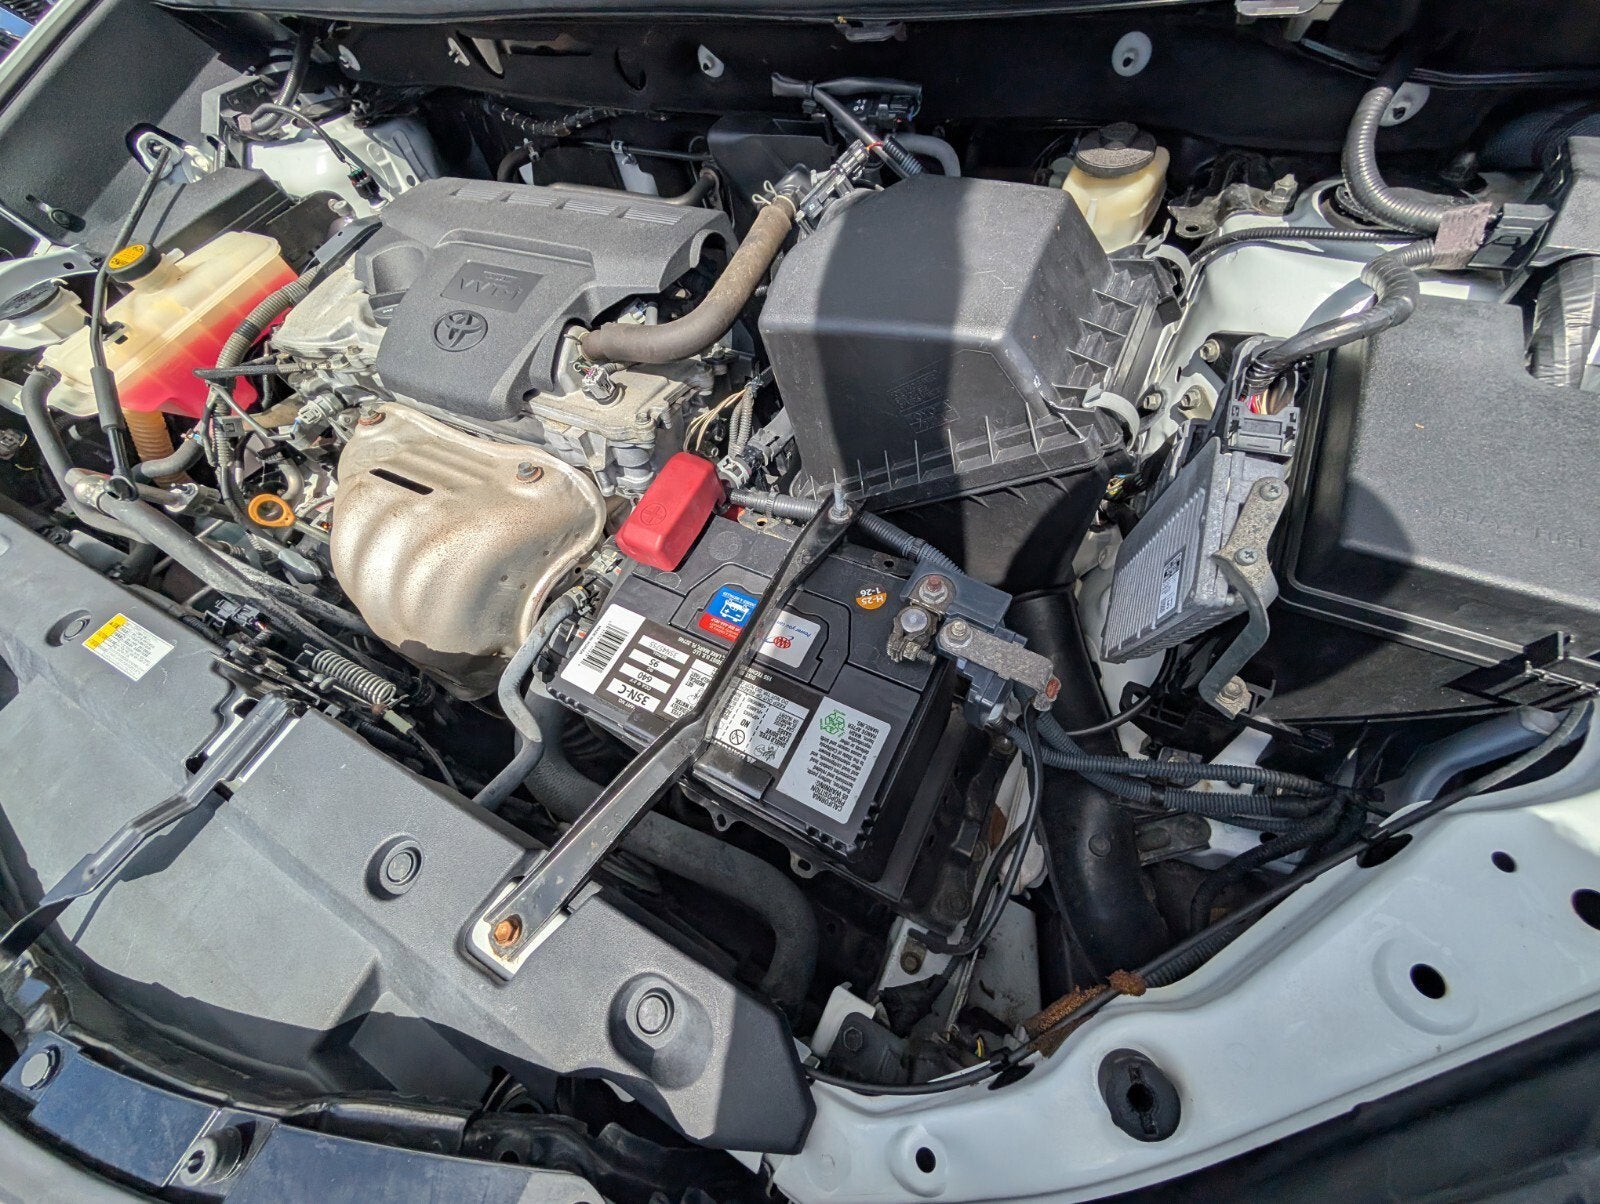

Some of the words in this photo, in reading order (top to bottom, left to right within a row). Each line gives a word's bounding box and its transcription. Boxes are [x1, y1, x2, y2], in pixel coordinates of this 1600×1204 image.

[774, 634, 790, 650] AAA
[648, 657, 660, 668] 95
[637, 671, 652, 683] 640
[617, 684, 649, 705] 35N-C
[739, 717, 750, 728] NO
[810, 785, 845, 804] PROPOSITION
[814, 780, 841, 796] WARNING:
[811, 793, 842, 810] CALIFORNIA
